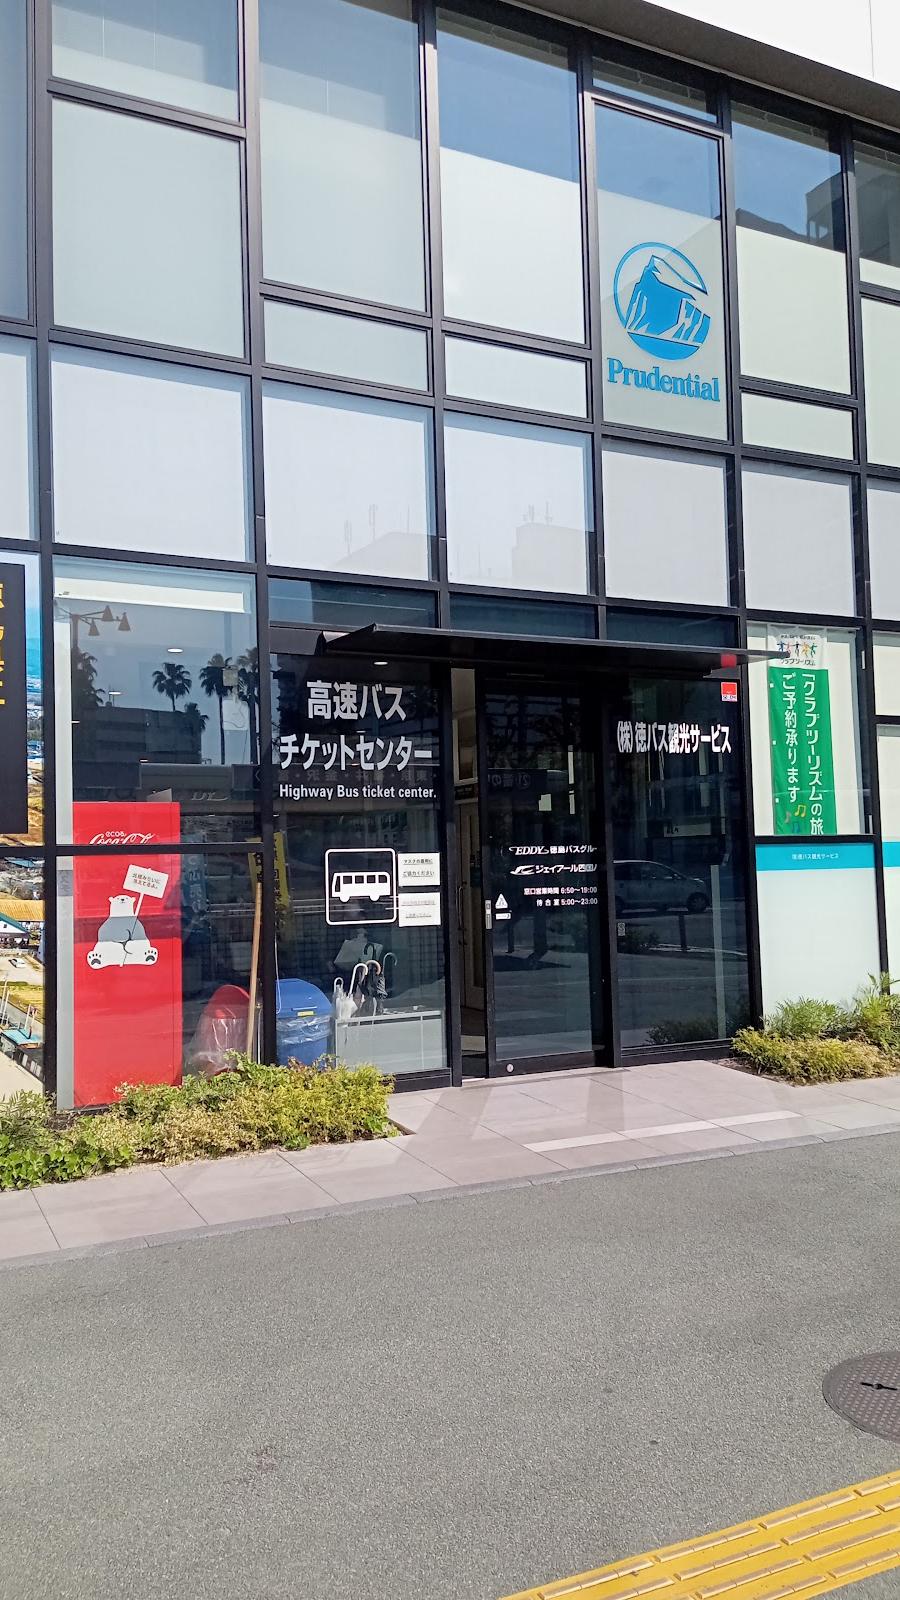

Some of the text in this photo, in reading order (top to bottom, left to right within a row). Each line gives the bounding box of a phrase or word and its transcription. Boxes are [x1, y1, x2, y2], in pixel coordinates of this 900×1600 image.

[606, 357, 720, 401] Prudential
[306, 680, 407, 721] 高速バス
[279, 733, 433, 772] チケットセンター
[782, 672, 800, 803] ご予約承ります
[279, 784, 437, 801] Highway Bus ticket center.
[508, 846, 550, 856] EDDY
